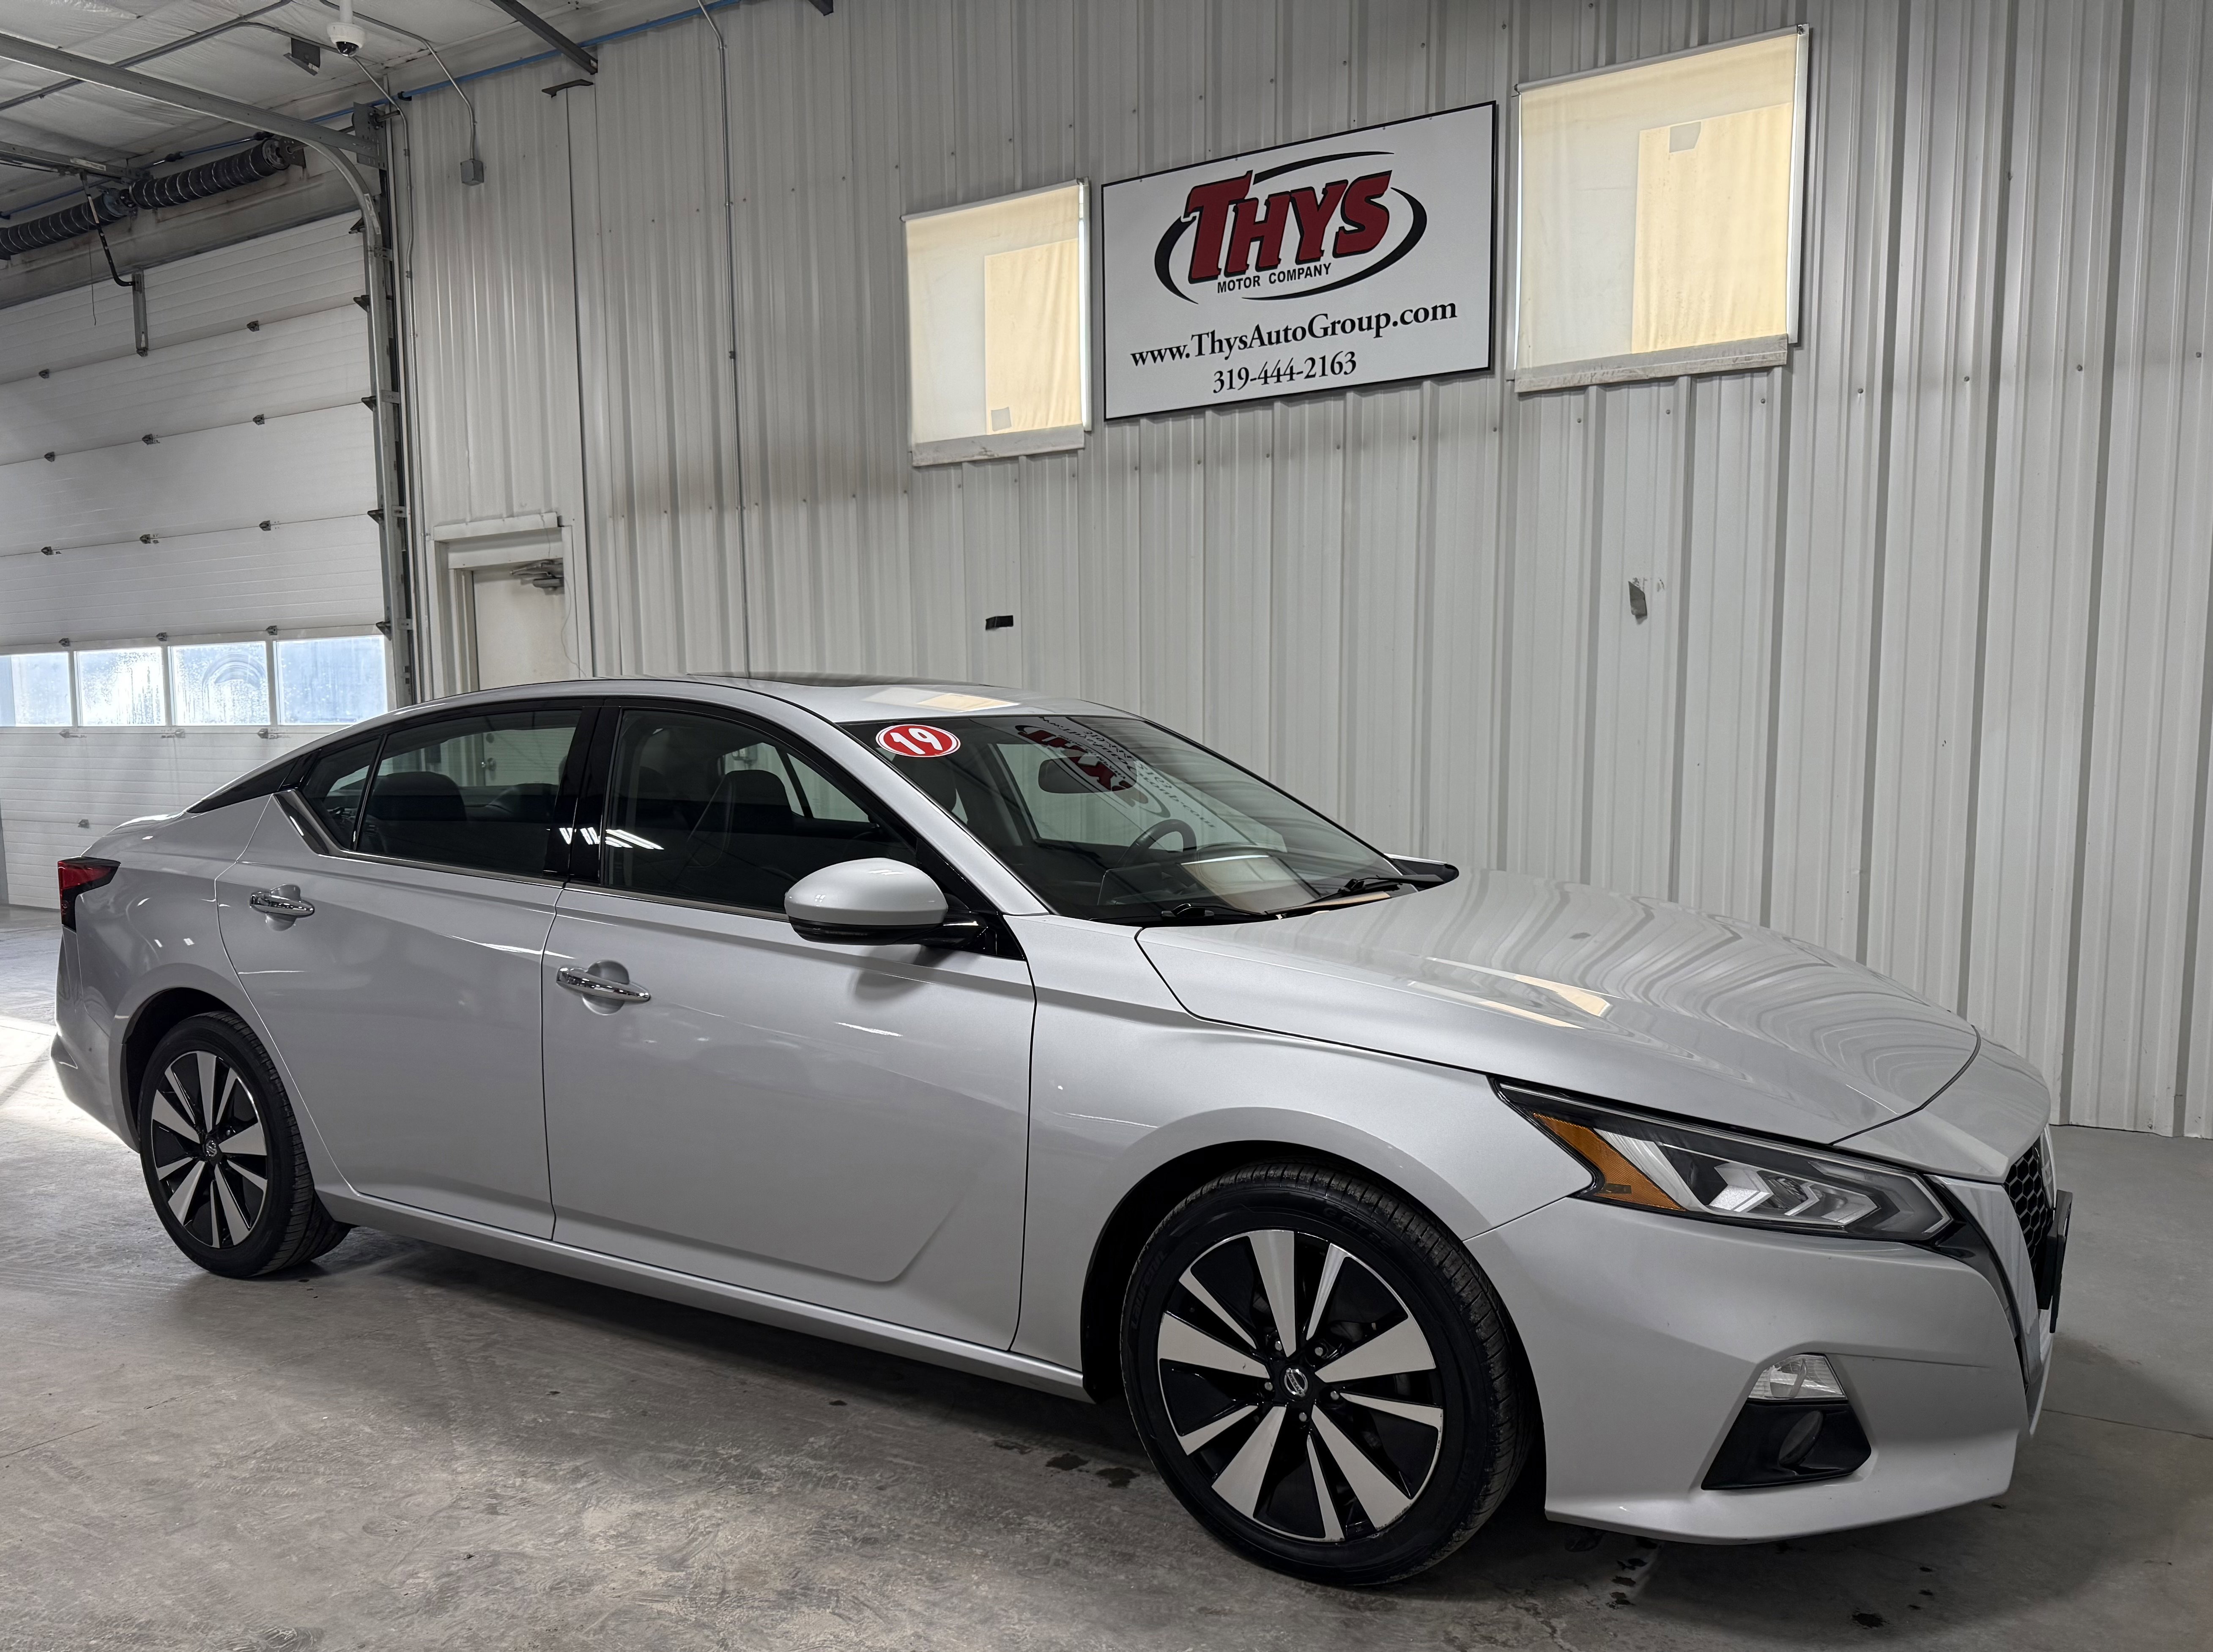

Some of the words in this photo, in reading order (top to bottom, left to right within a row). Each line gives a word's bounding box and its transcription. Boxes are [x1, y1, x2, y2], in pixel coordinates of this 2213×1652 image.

[1183, 170, 1392, 284] THYS
[1217, 275, 1261, 293] MOTOR
[1268, 263, 1332, 285] COMPANY
[1131, 302, 1457, 367] www.ThysAutoGroup.com
[1213, 351, 1357, 394] 319-444-2163
[890, 728, 943, 755] 19
